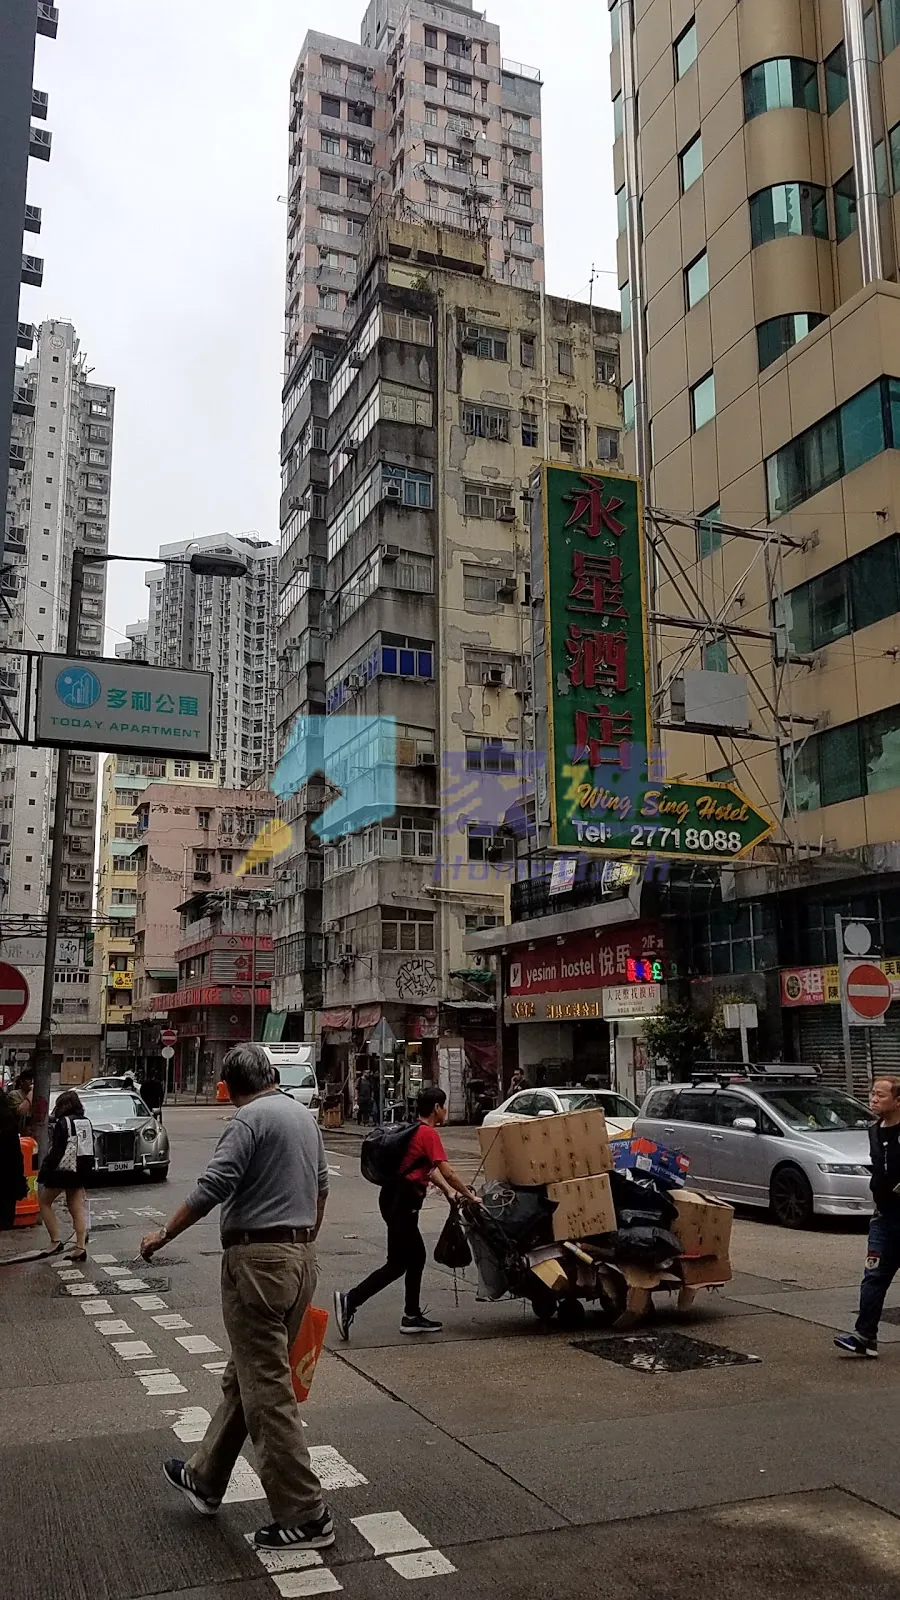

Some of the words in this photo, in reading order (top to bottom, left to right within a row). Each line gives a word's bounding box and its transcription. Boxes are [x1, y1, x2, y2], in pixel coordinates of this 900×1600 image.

[562, 474, 634, 769] 永星酒店
[107, 689, 199, 716] 多利公寓
[50, 716, 103, 729] TODAY
[110, 722, 201, 739] APARTMENT
[577, 784, 633, 819] Wing
[640, 791, 690, 824] Sing
[695, 796, 749, 822] Hotel
[526, 962, 559, 988] yesinn
[561, 953, 595, 978] hostel
